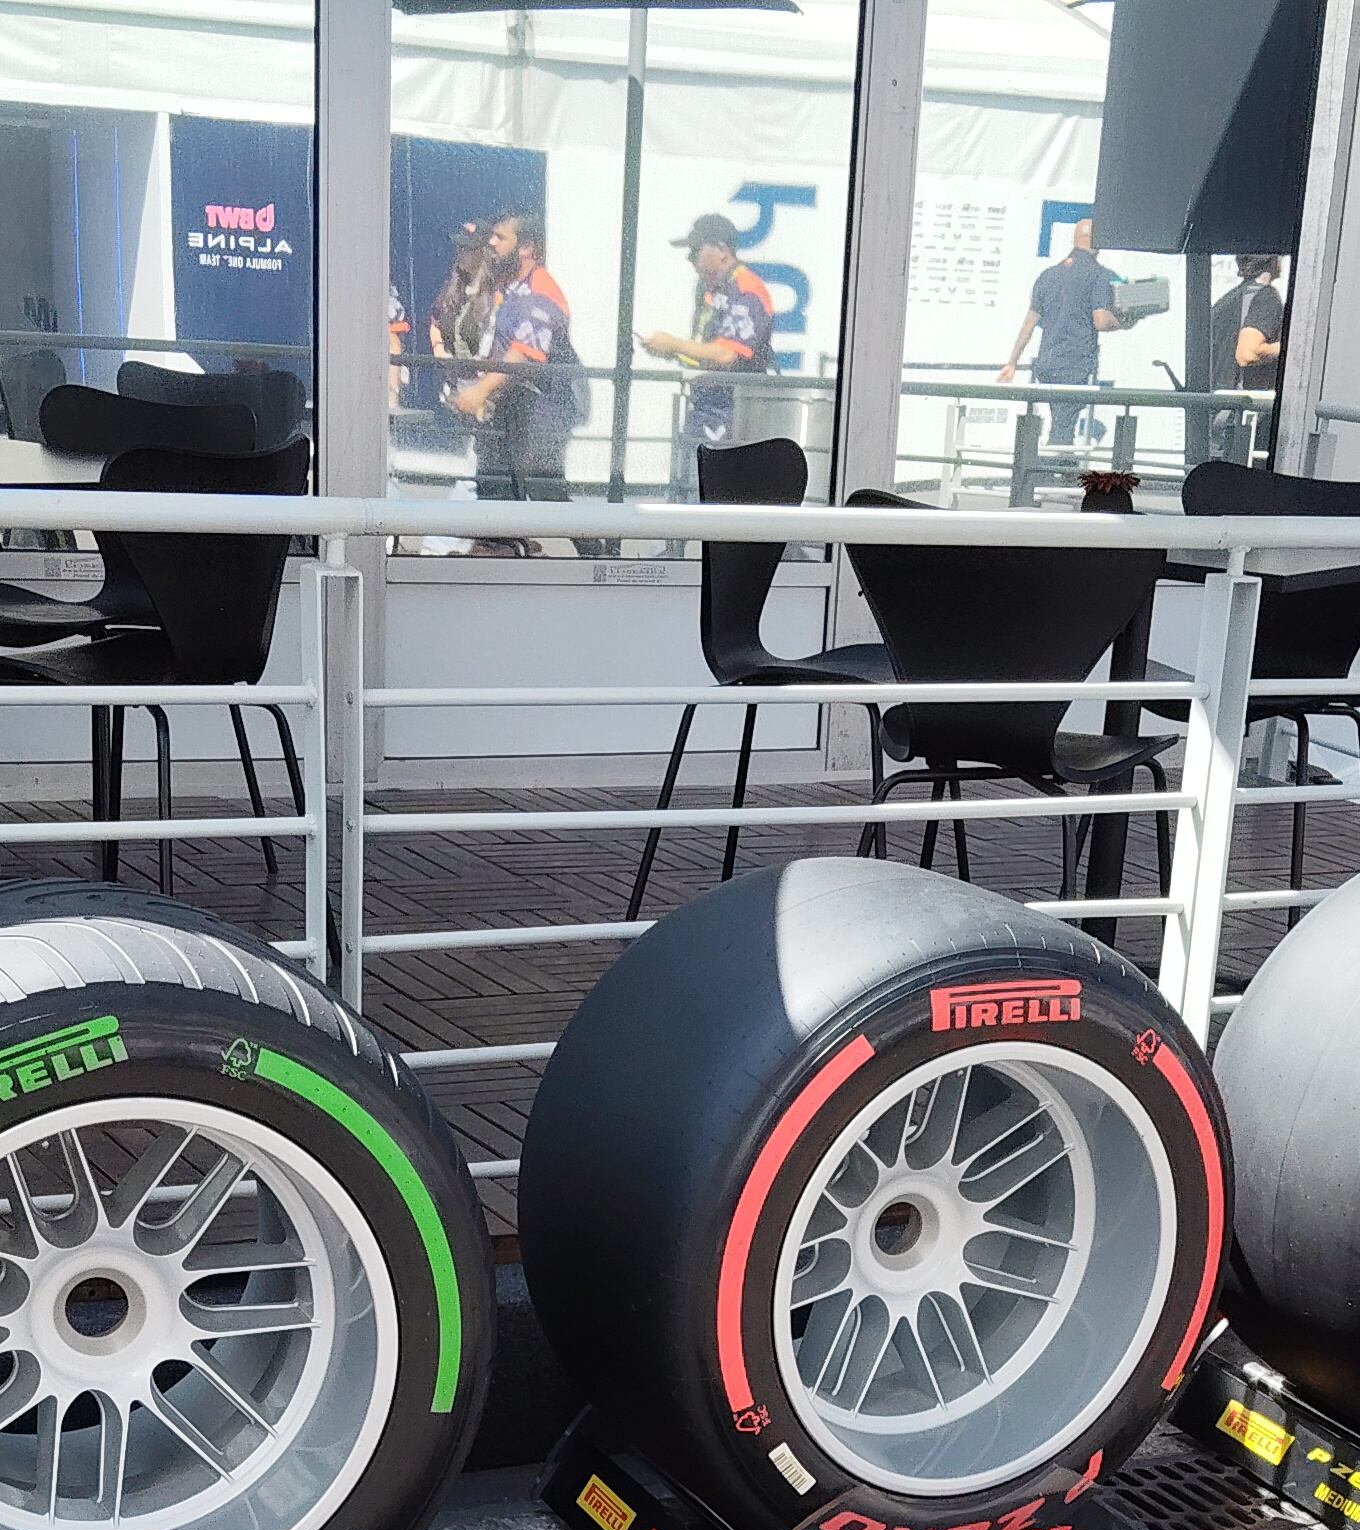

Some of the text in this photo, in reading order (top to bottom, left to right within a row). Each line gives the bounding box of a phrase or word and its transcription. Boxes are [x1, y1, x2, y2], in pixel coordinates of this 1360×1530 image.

[930, 979, 1082, 1032] PIRELLI
[1225, 1409, 1286, 1455] PIRELLI
[1307, 1447, 1334, 1464] P
